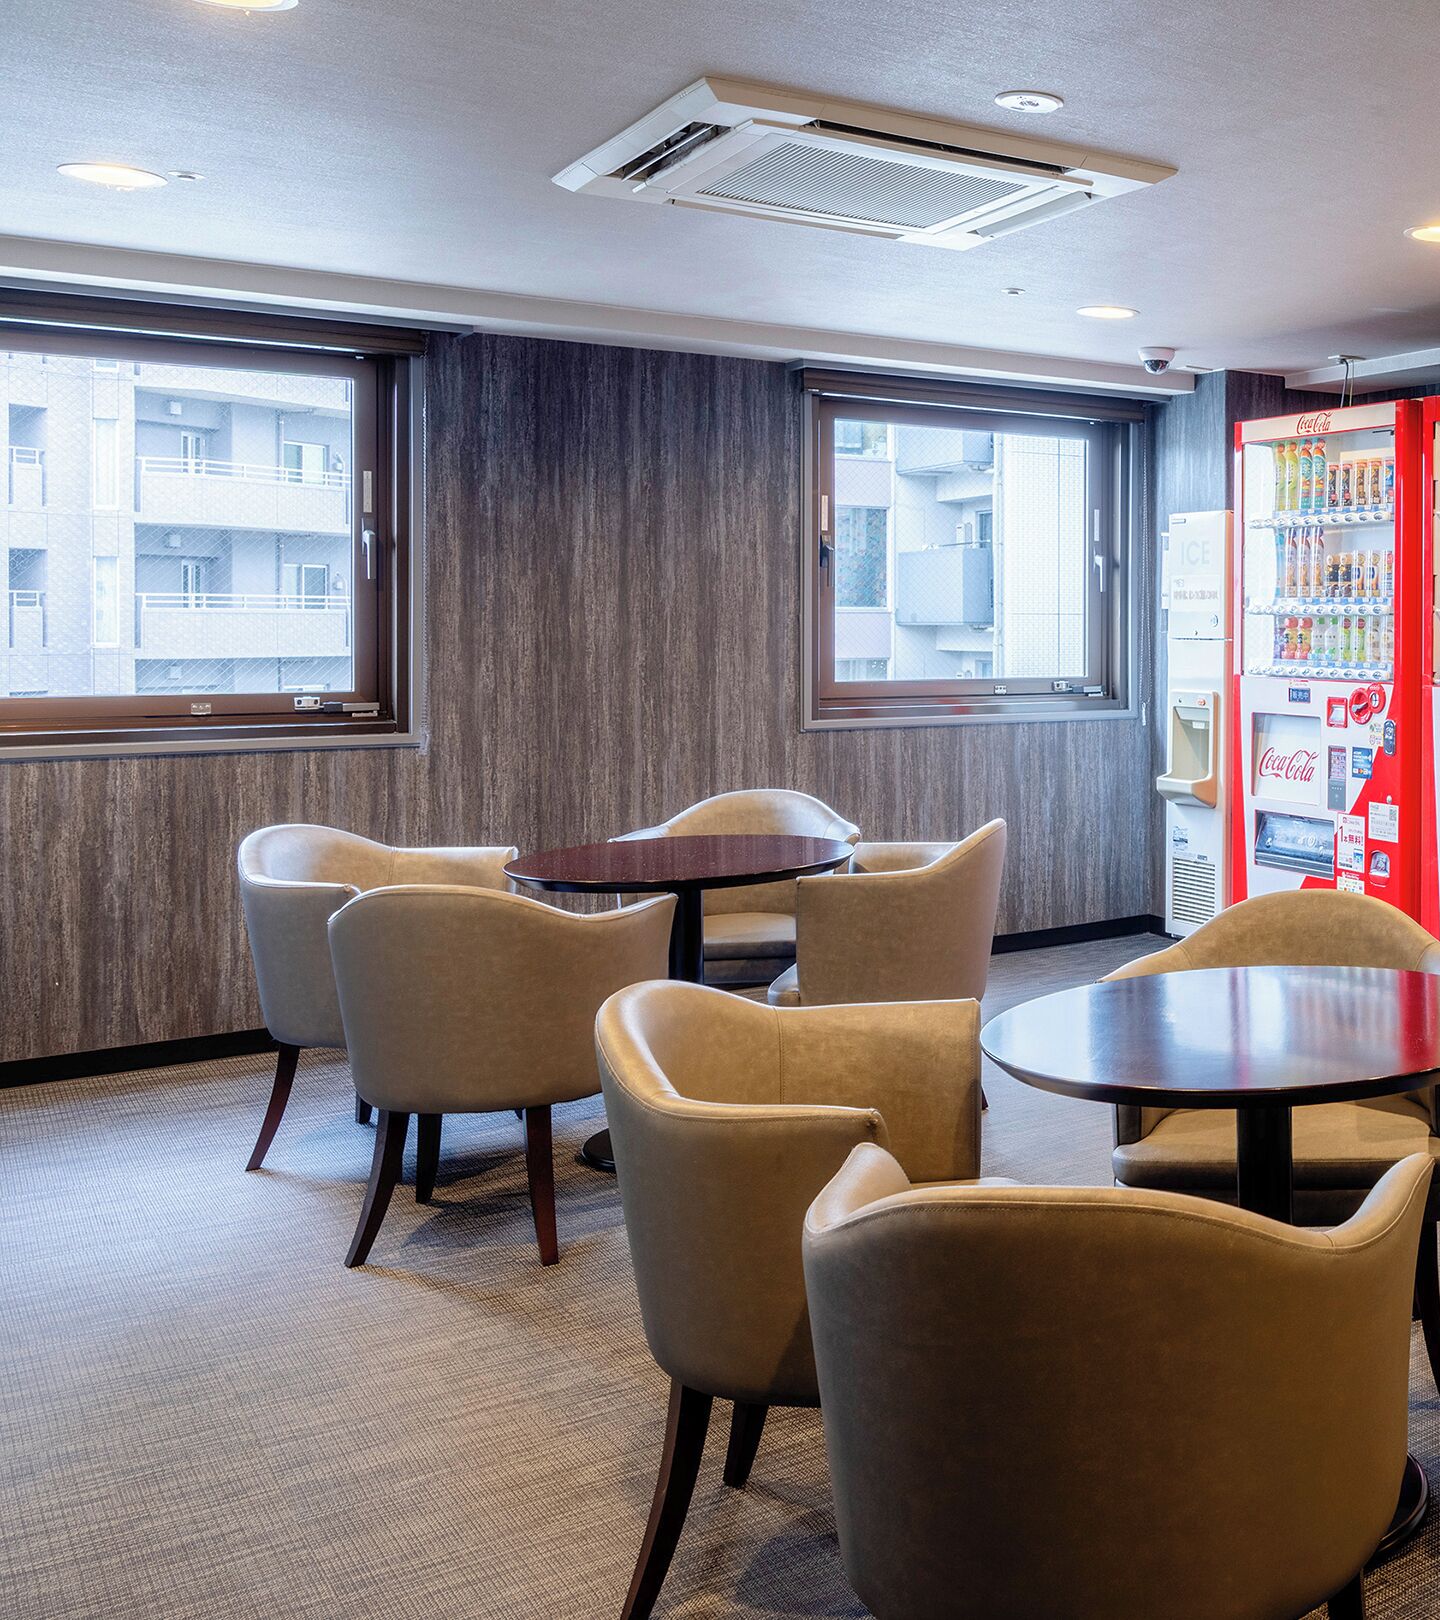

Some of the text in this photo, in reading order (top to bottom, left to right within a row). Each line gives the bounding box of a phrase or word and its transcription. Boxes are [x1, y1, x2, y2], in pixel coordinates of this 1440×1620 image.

[1296, 410, 1334, 435] Coca-Cola
[1180, 540, 1211, 566] ICE
[1258, 746, 1320, 783] Coca-Cola
